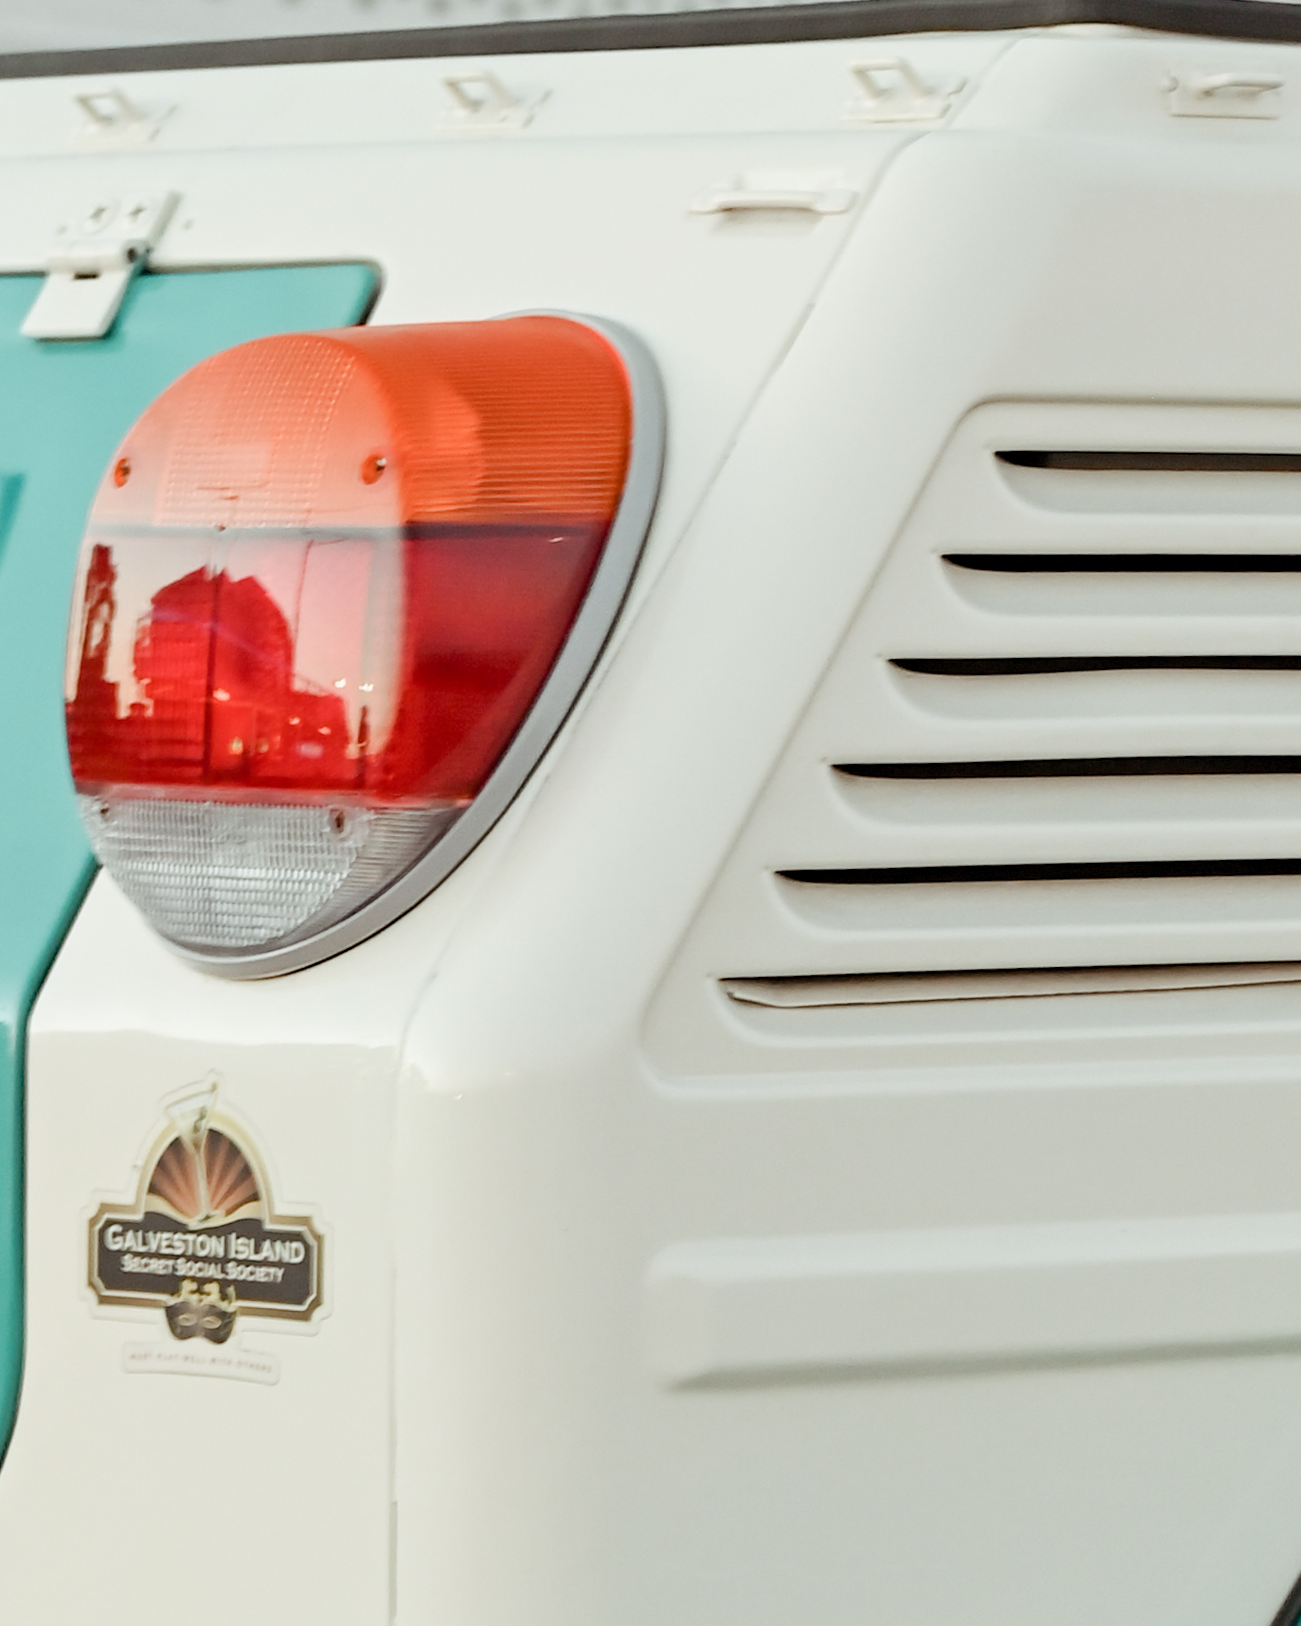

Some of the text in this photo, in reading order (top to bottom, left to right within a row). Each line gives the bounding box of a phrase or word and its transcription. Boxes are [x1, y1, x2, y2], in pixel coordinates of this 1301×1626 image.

[106, 1225, 306, 1264] GALVESTON ISLAND
[121, 1254, 285, 1283] SECRET SOCIAL SOCIETY
